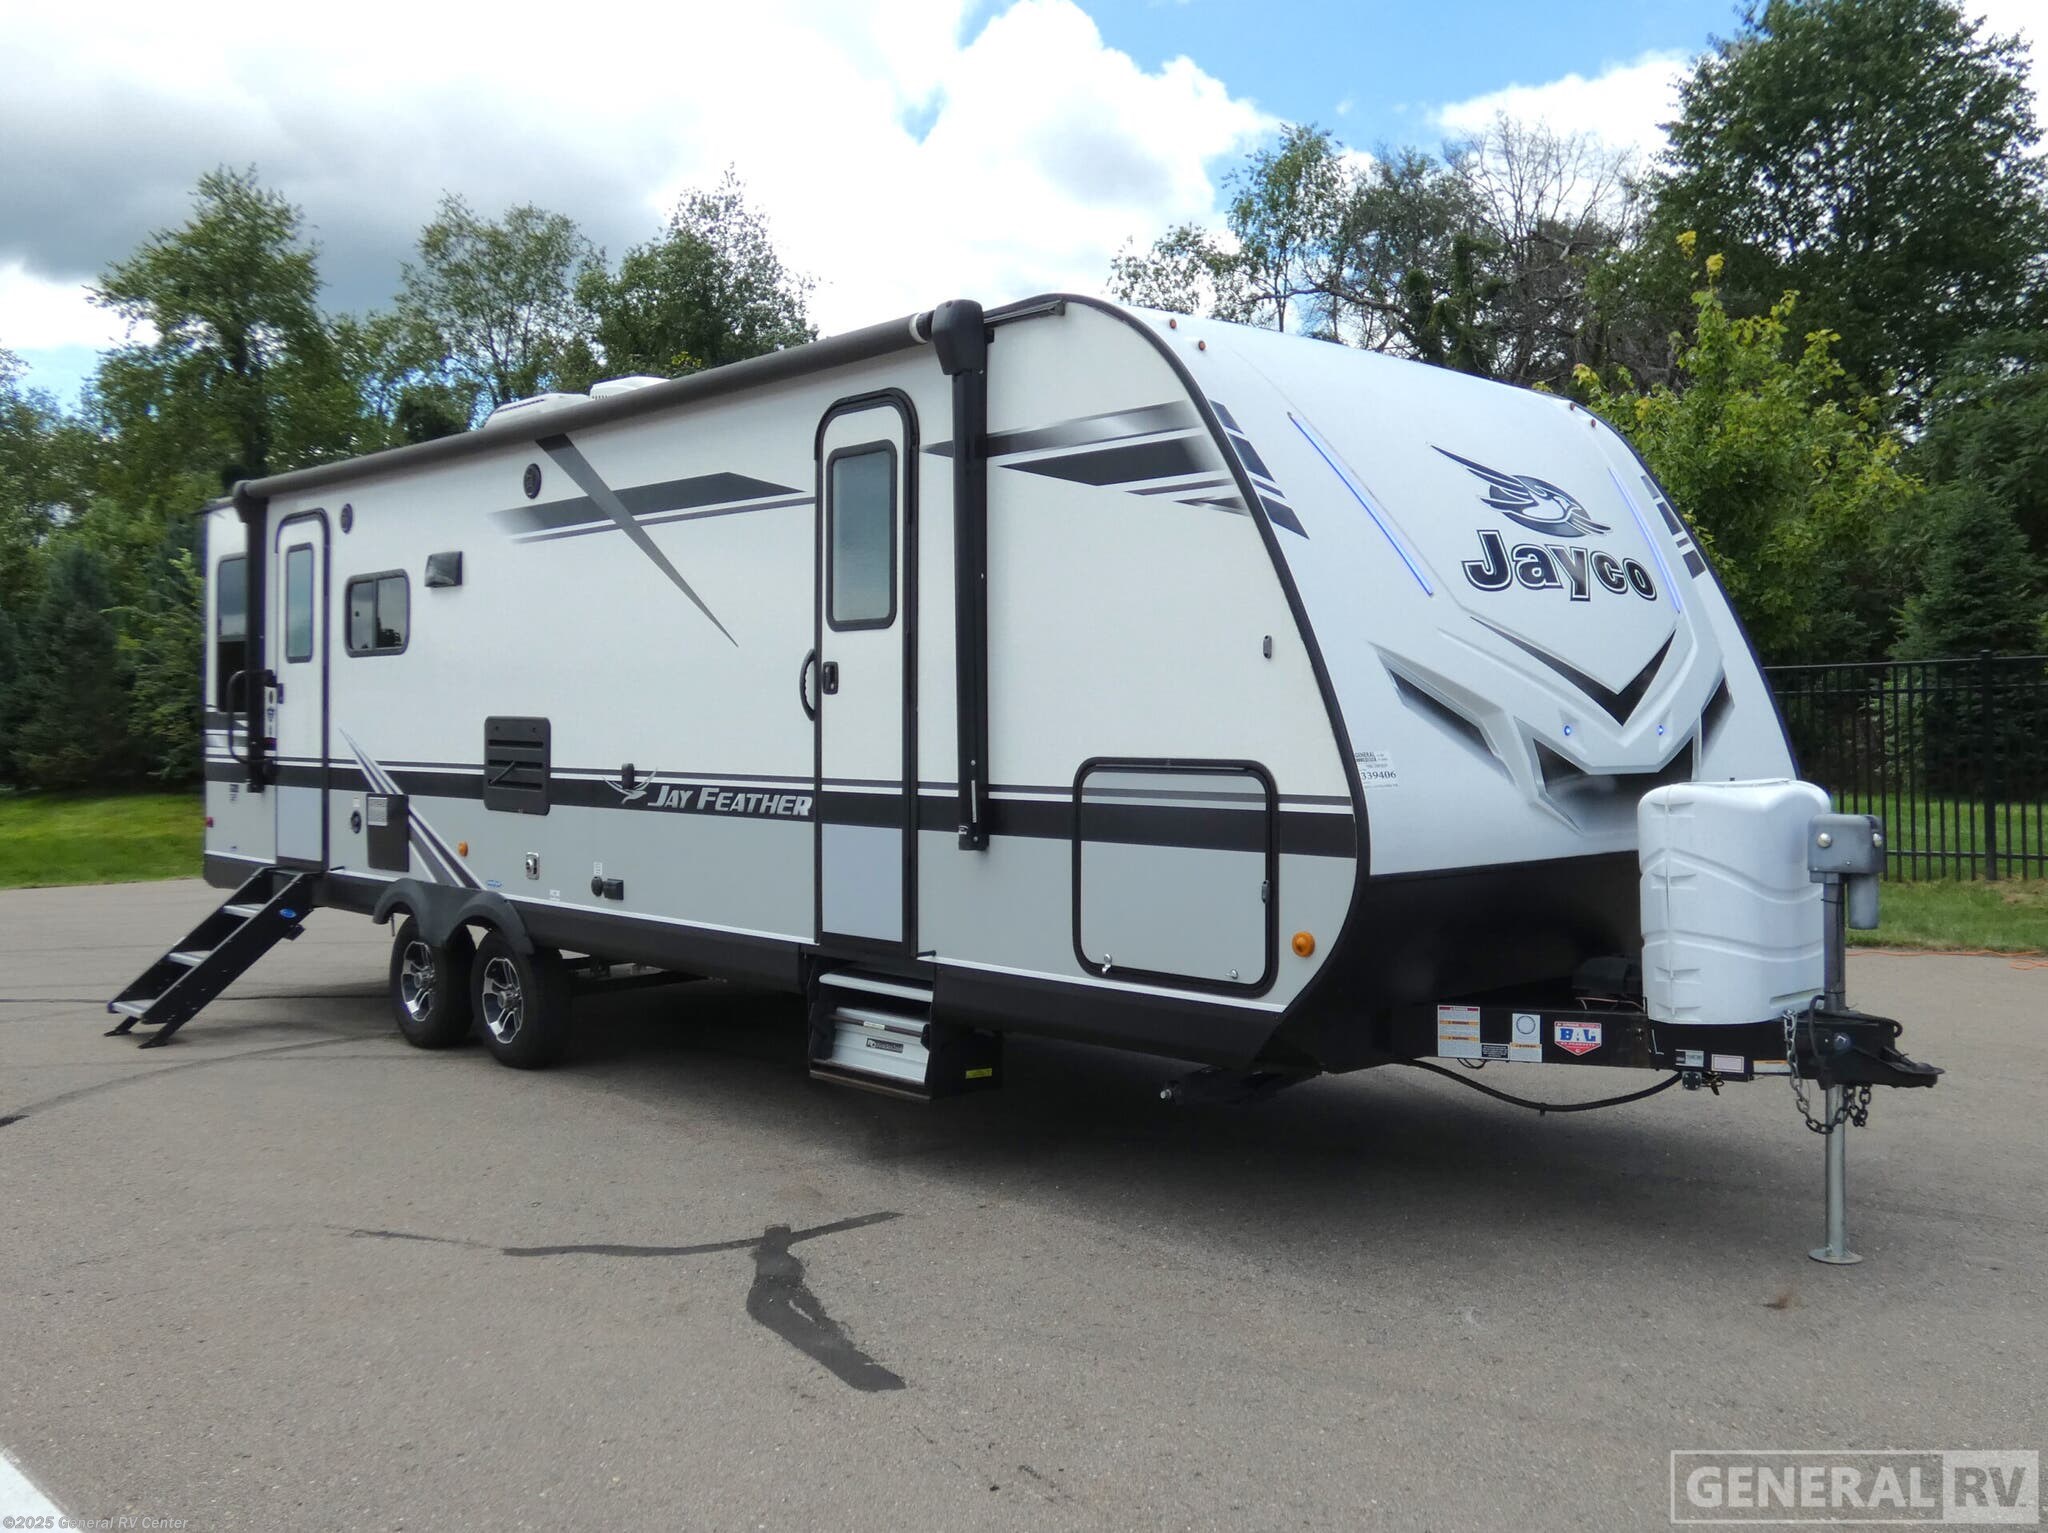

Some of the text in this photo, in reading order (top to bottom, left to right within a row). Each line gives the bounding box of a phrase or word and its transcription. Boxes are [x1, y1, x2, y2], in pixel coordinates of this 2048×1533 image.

[1461, 529, 1658, 602] Jayco
[1361, 771, 1397, 780] 339406
[648, 785, 813, 816] JAY FEATHER
